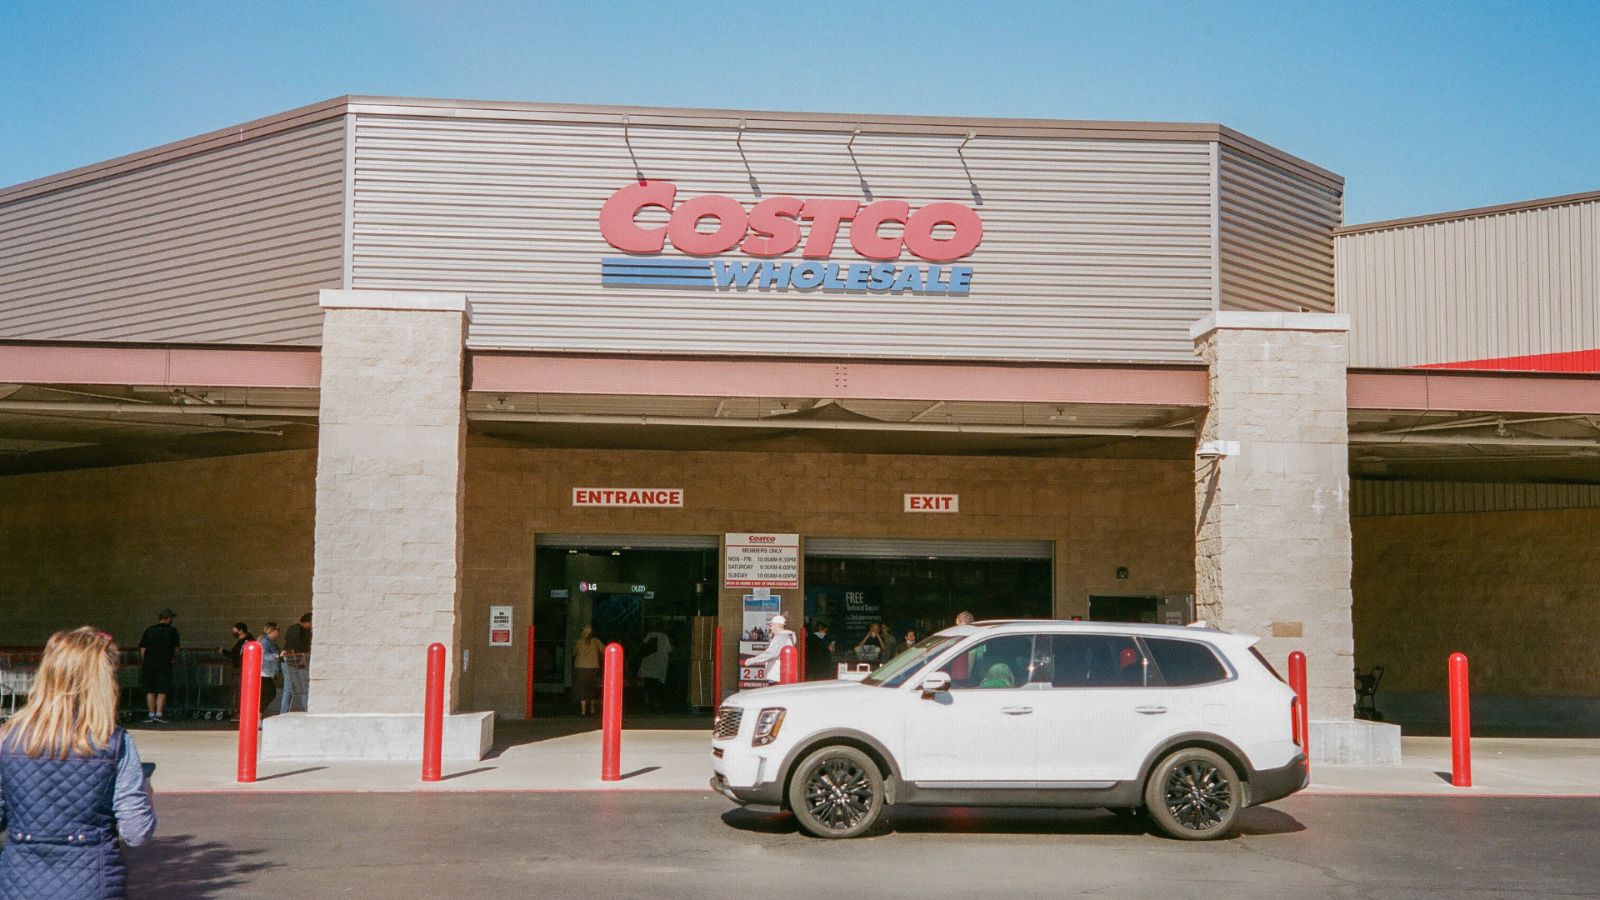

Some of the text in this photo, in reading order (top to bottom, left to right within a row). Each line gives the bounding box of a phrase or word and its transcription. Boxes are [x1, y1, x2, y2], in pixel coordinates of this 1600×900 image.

[599, 180, 983, 261] COSTCO
[713, 260, 973, 292] WHOLESALE
[575, 490, 681, 505] ENTRANCE
[910, 496, 953, 510] EXIT
[846, 592, 864, 604] FREE
